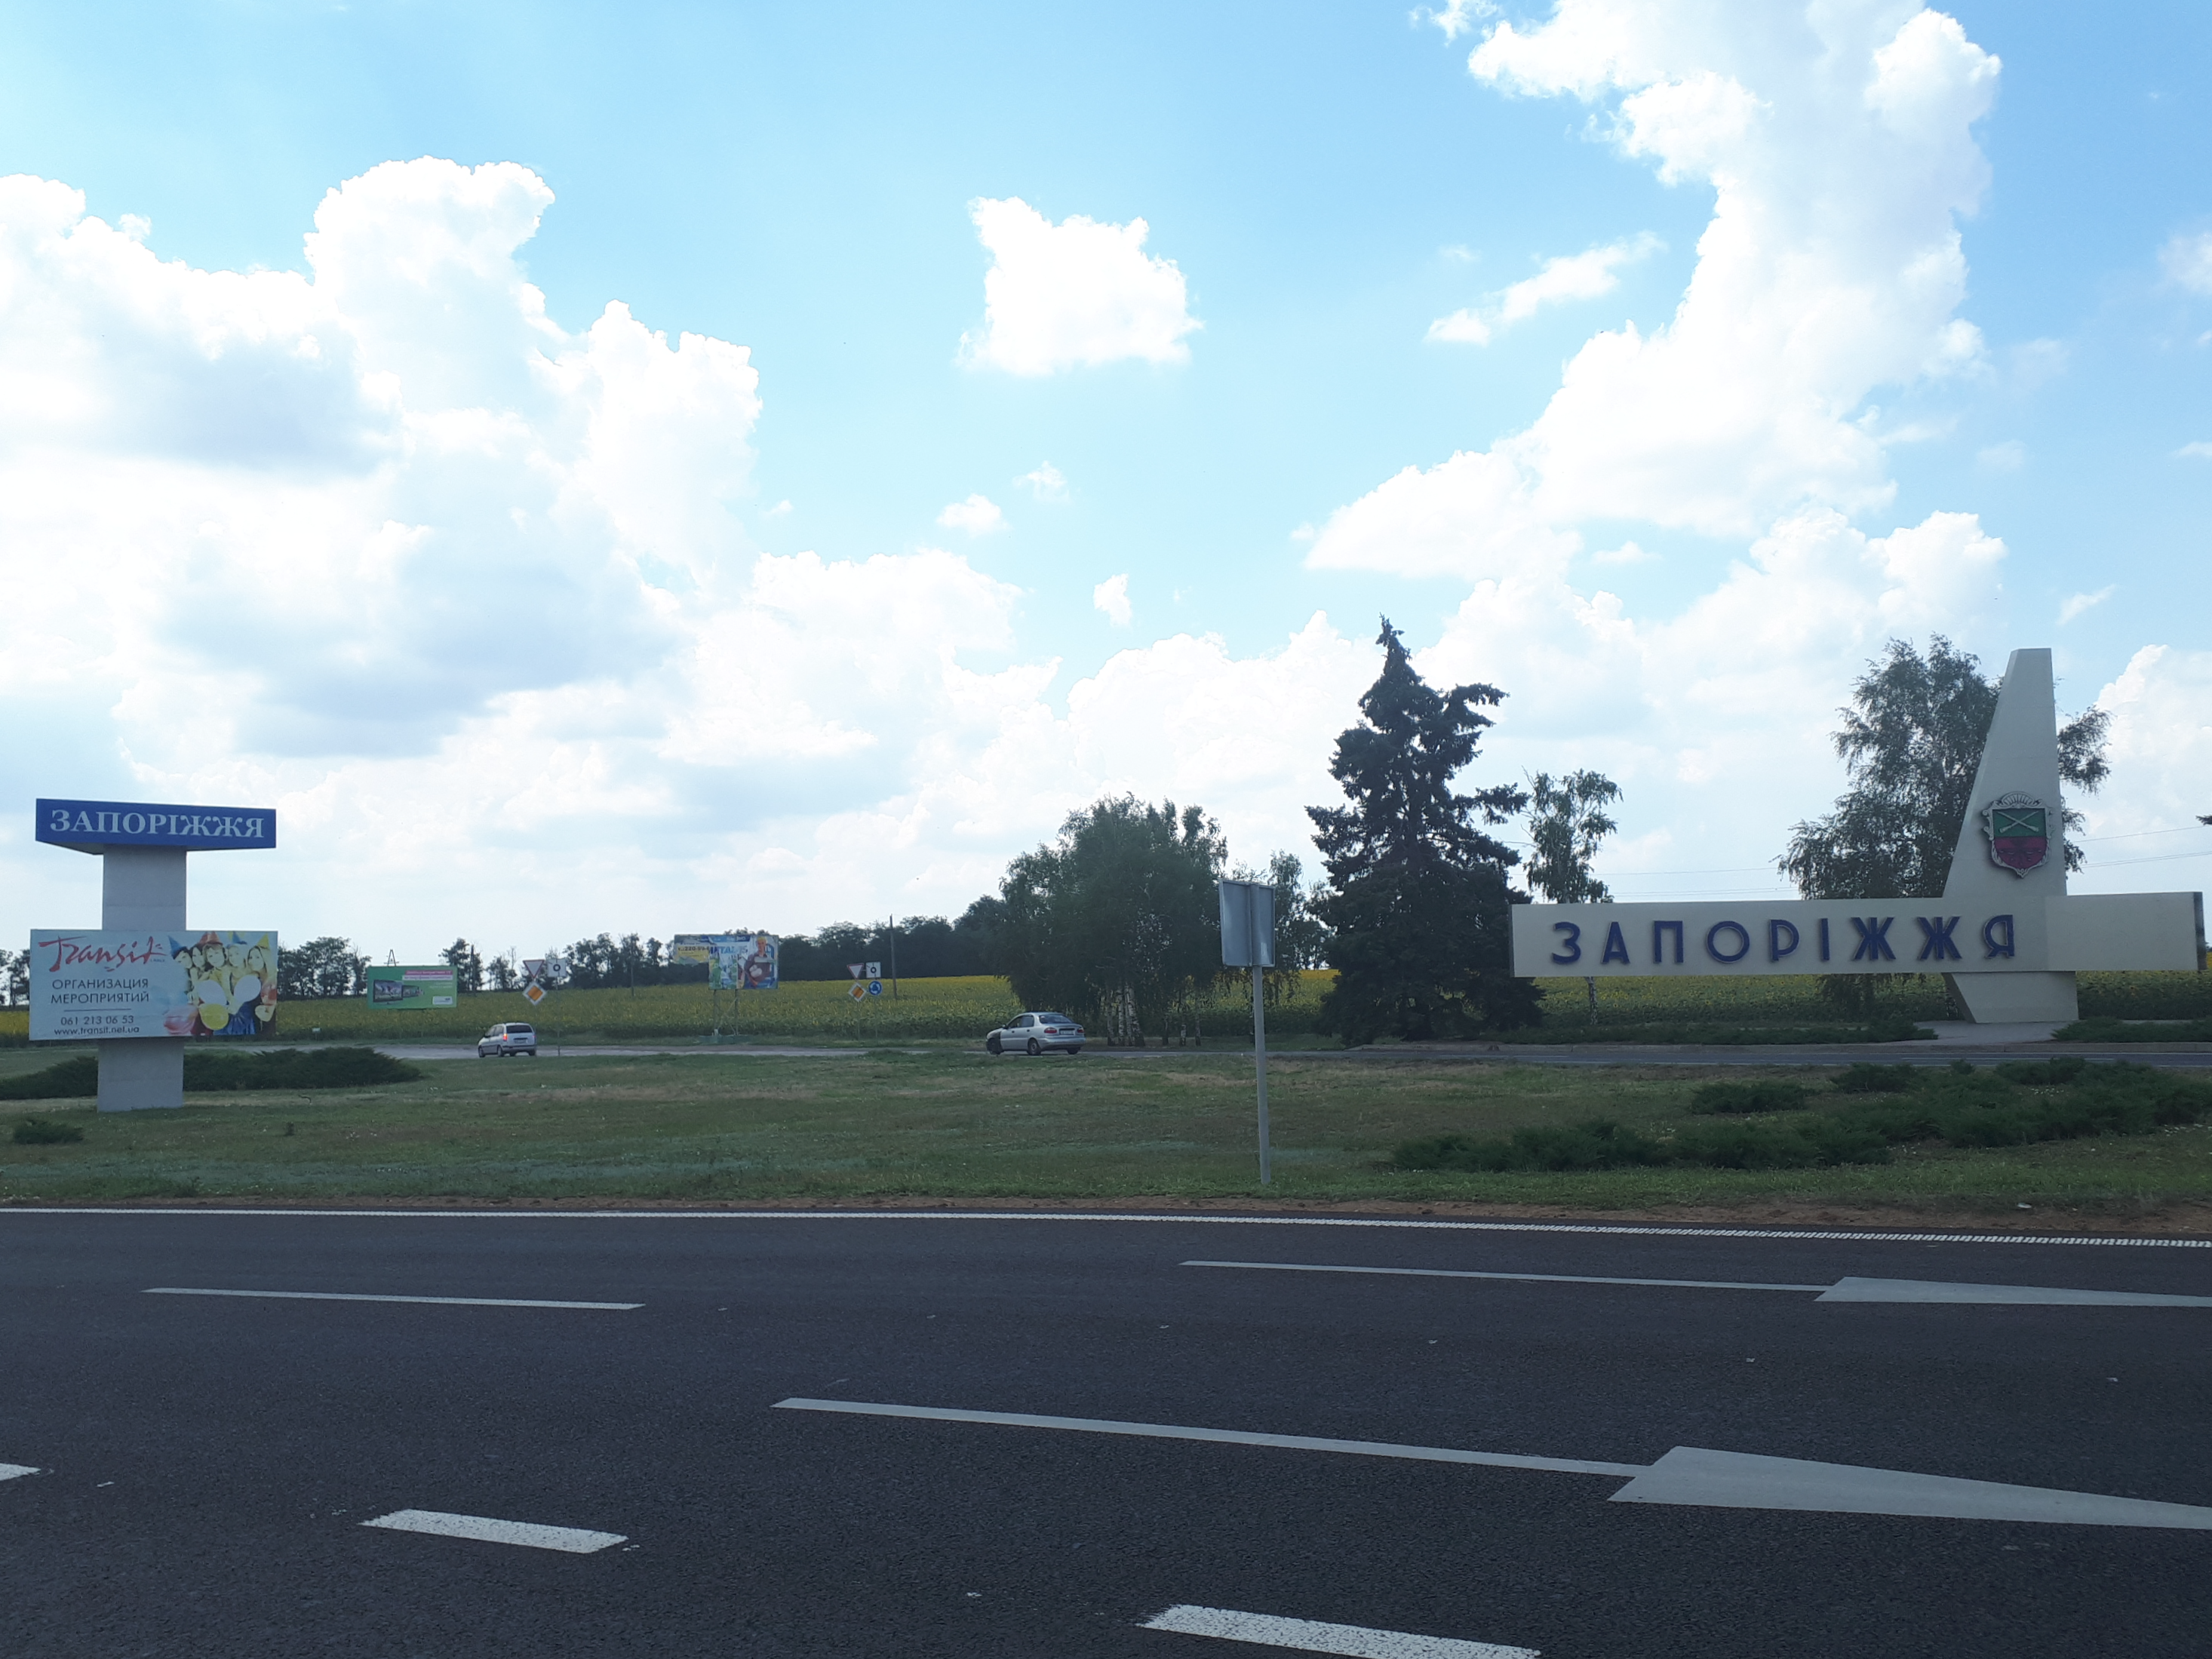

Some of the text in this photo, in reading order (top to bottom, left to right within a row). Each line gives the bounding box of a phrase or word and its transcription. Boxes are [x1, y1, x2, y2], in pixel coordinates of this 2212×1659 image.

[50, 809, 265, 838] ЗАПОРІЖЖЯ
[1551, 914, 2017, 965] ЗАПОРІЖЖЯ
[38, 935, 167, 972] Transit
[52, 979, 149, 990] ОРГАНИЗАЦИЯ
[51, 991, 149, 1004] МЕРОПРИЯТИЙ
[60, 1017, 78, 1025] 061
[84, 1016, 102, 1025] 213
[121, 1015, 134, 1024] 53
